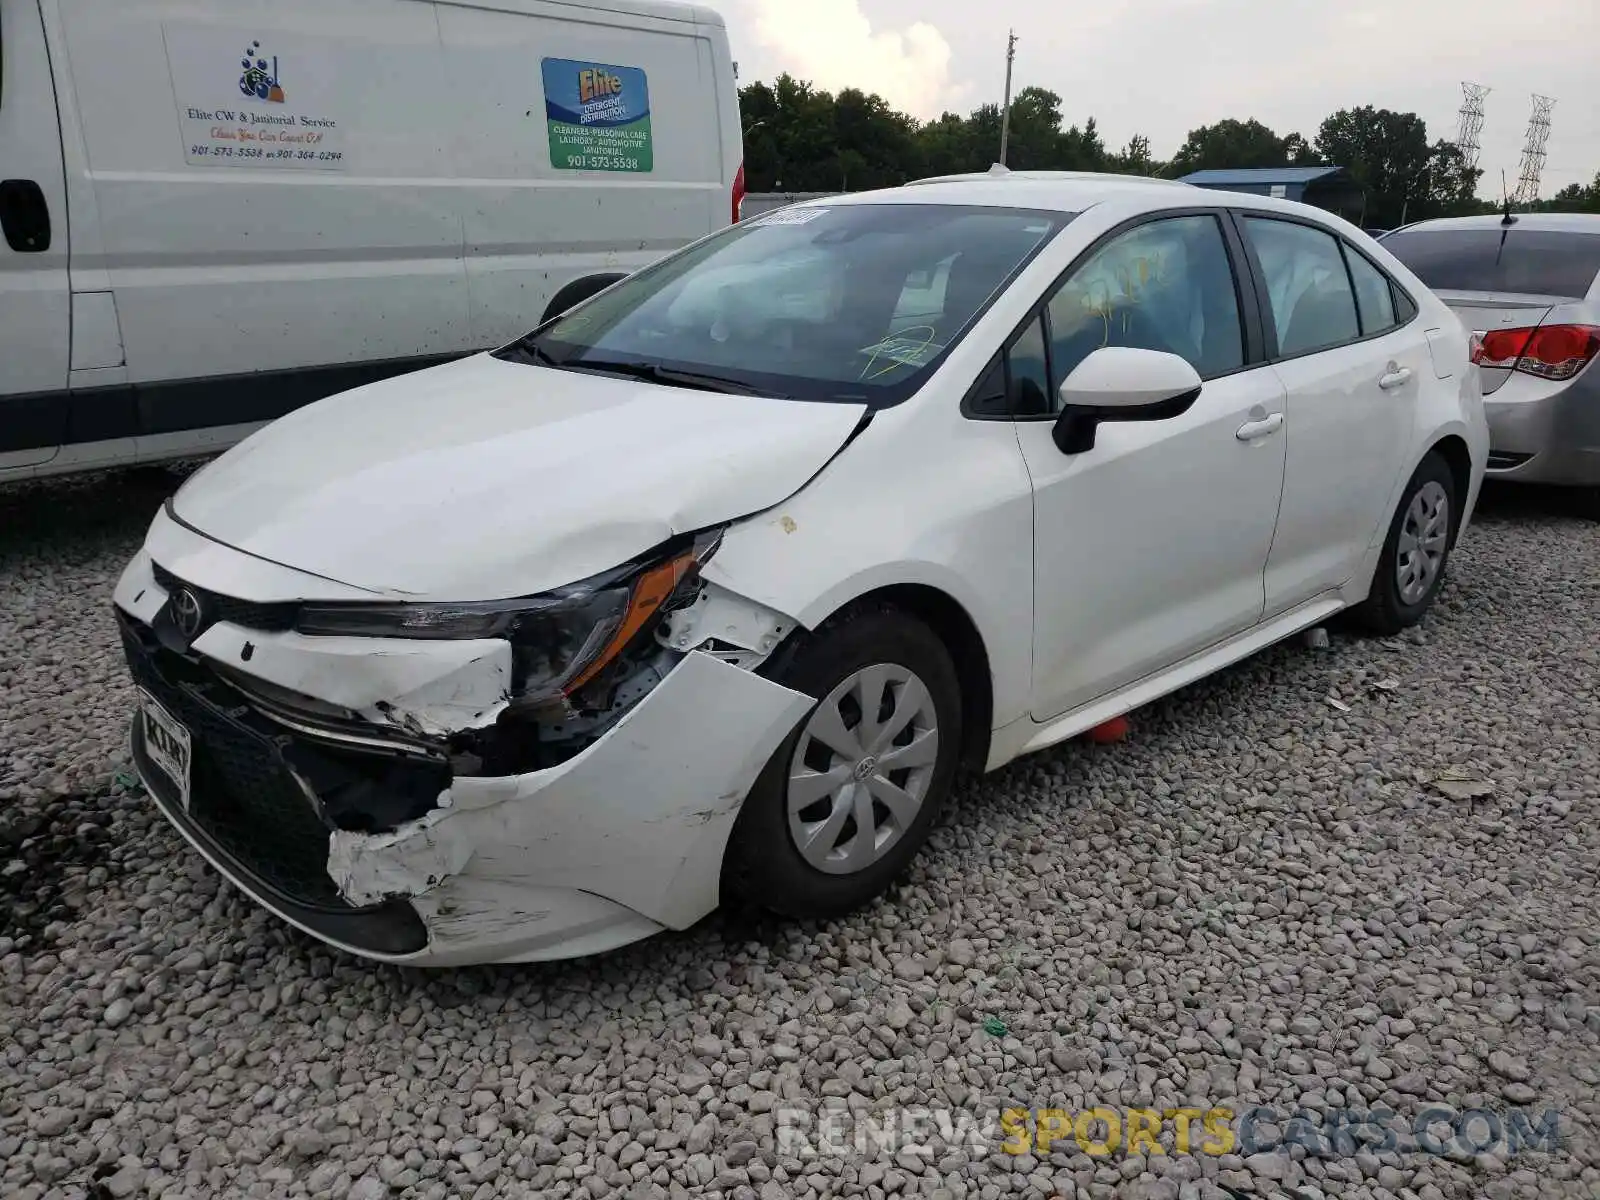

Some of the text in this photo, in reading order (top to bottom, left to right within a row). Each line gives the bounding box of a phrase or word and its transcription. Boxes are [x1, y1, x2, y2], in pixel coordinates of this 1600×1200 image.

[578, 68, 622, 104] Elite
[584, 98, 621, 113] DETERGENT
[187, 108, 336, 128] Elite CW & Janitorial Service
[559, 136, 643, 148] LAUNDRY AUTOMOTIVE
[583, 146, 623, 156] JANITORIAL
[567, 155, 638, 169] 901-573-5538
